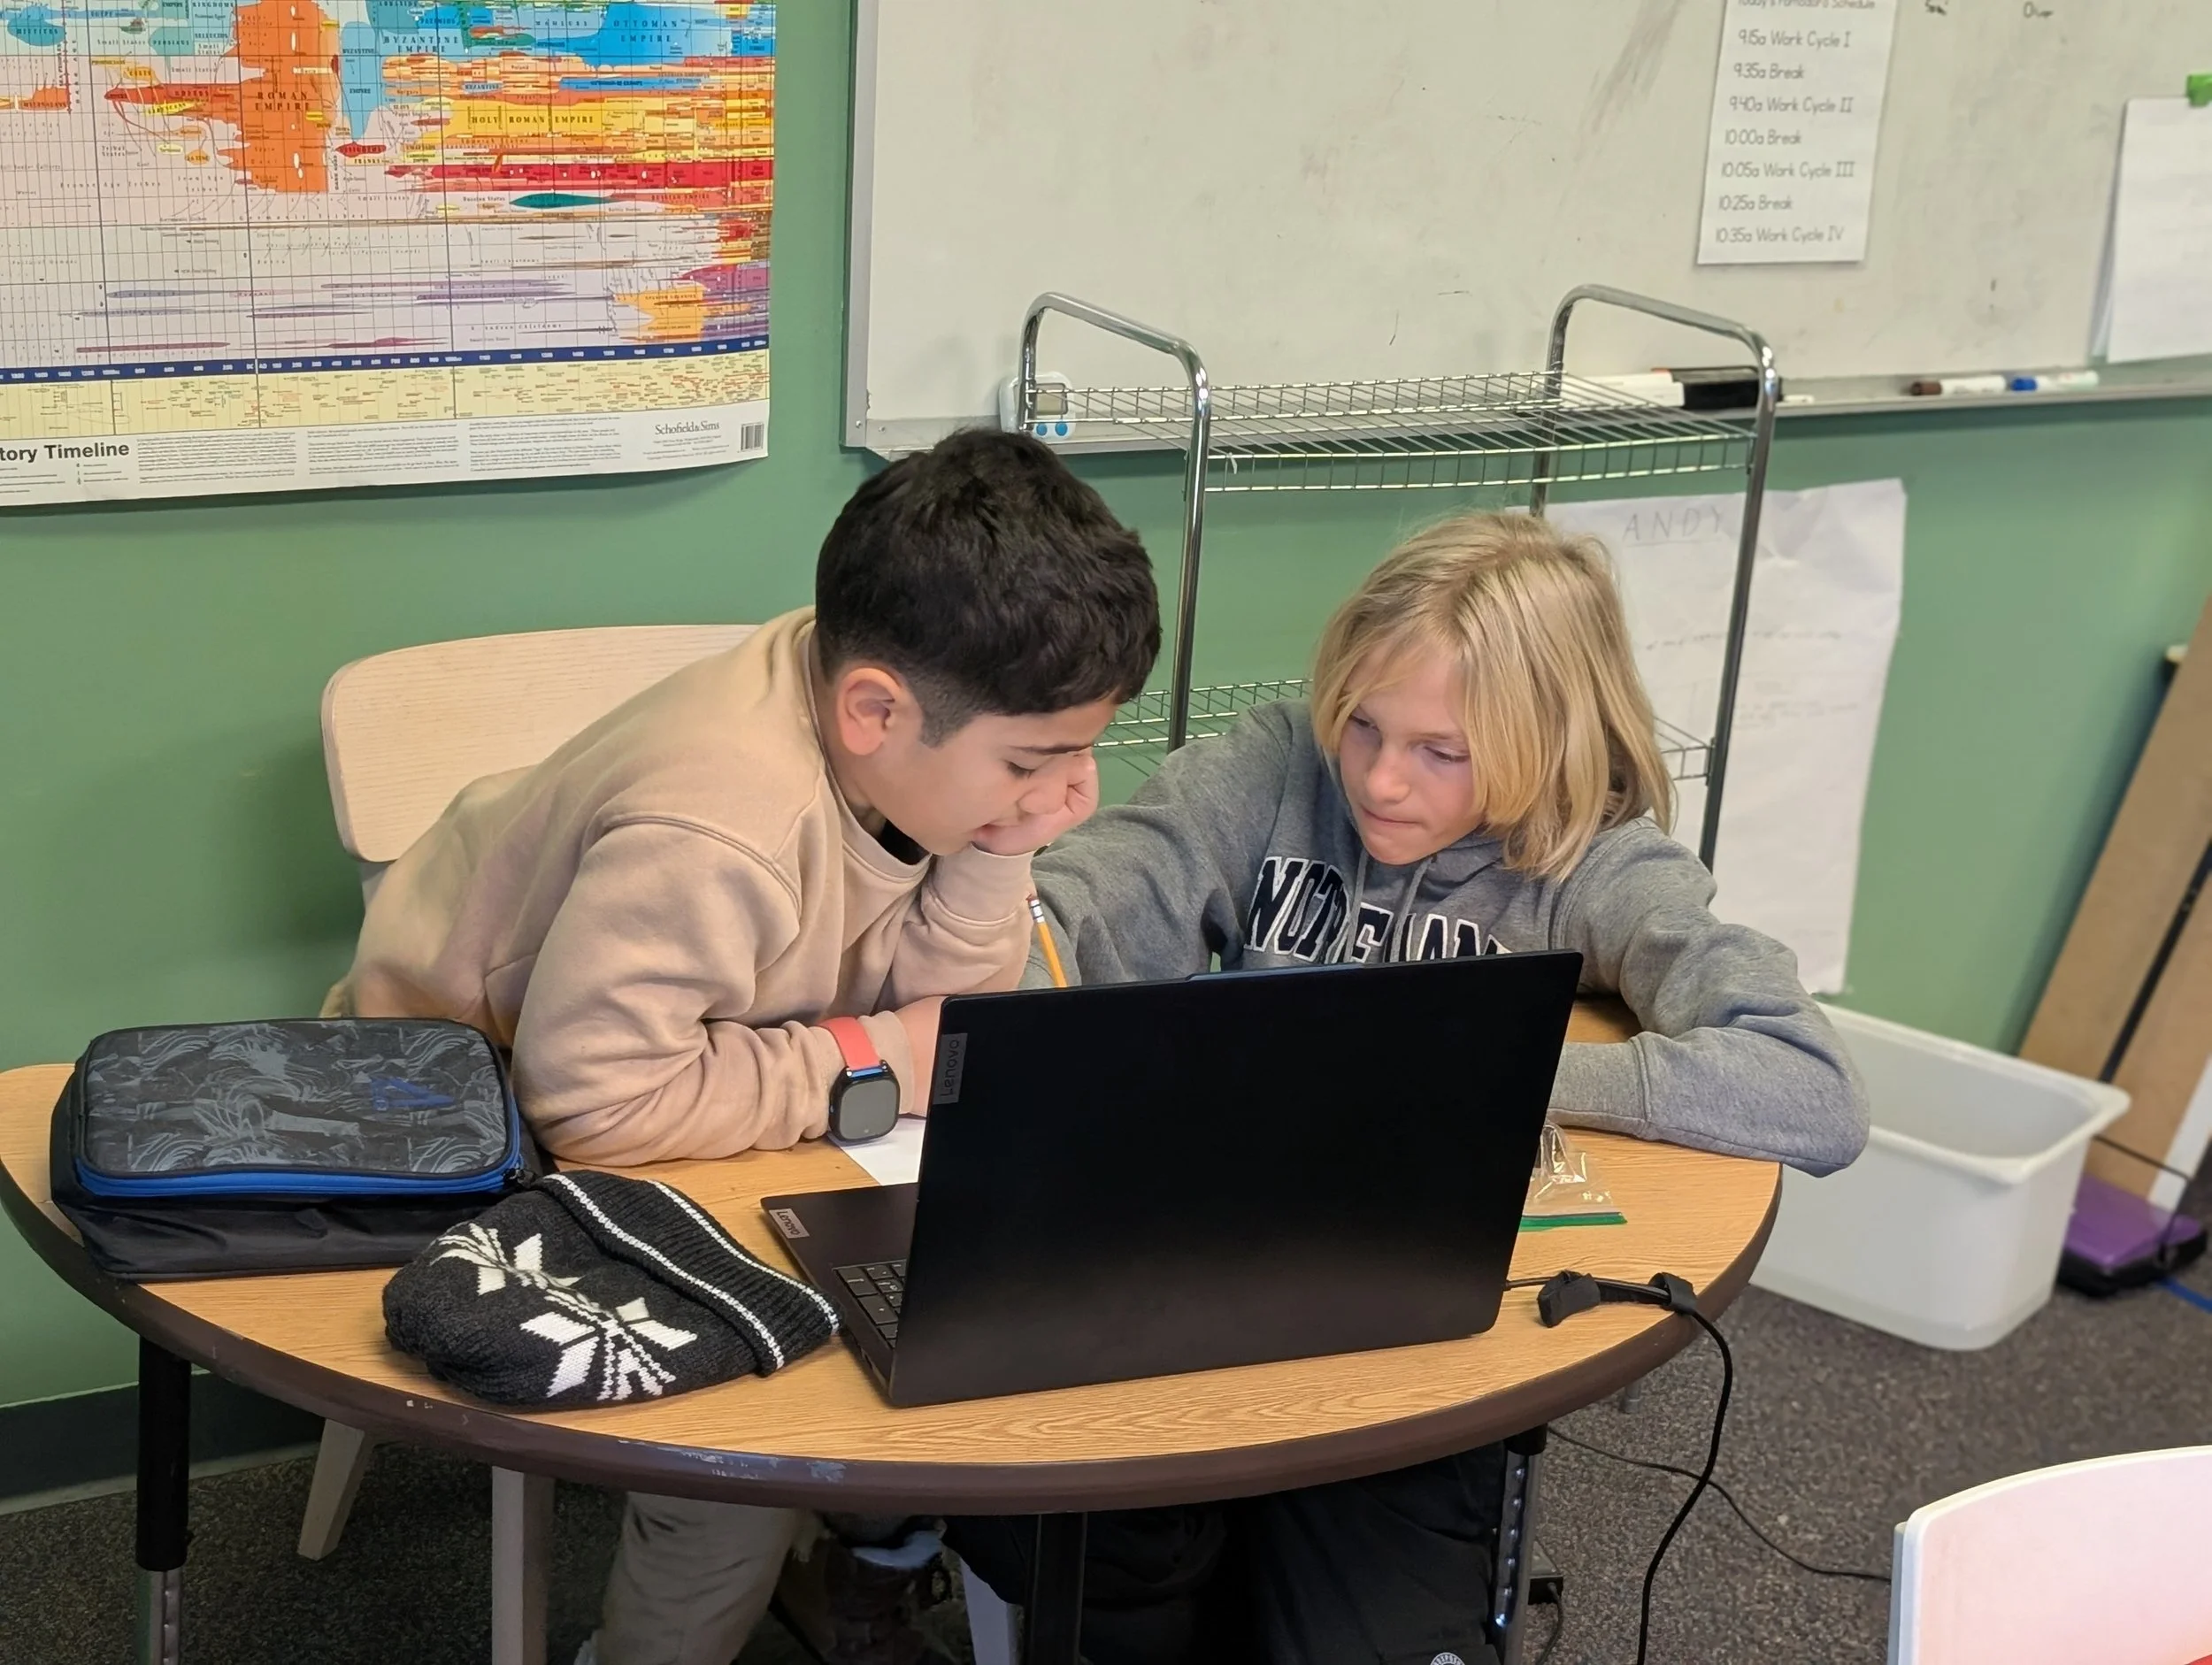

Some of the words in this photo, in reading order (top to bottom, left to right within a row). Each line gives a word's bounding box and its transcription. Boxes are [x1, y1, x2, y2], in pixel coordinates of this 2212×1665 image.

[613, 19, 679, 28] OTTOMAN
[619, 35, 672, 43] EMPIRE
[1770, 30, 1803, 45] Work
[1807, 31, 1840, 50] Cycle
[1843, 31, 1851, 48] I
[1769, 63, 1805, 80] Break
[257, 91, 308, 100] ROMAN
[256, 102, 311, 111] EMPIRE
[1767, 96, 1799, 112] Work
[1802, 96, 1836, 115] Cycle
[1839, 96, 1854, 113] II
[554, 115, 595, 124] EMPIRE
[1767, 129, 1801, 146] Break
[1763, 162, 1795, 178] Work
[1799, 162, 1832, 180] Cycle
[1835, 160, 1855, 178] III
[1758, 195, 1793, 211] Break
[1755, 227, 1788, 244] Work
[1792, 226, 1824, 245] Cycle
[1827, 226, 1845, 242] IV
[44, 442, 130, 459] Timeline
[1622, 504, 1724, 543] ANDY
[940, 1040, 959, 1096] Lenovo
[777, 1210, 801, 1236] Lenovo
